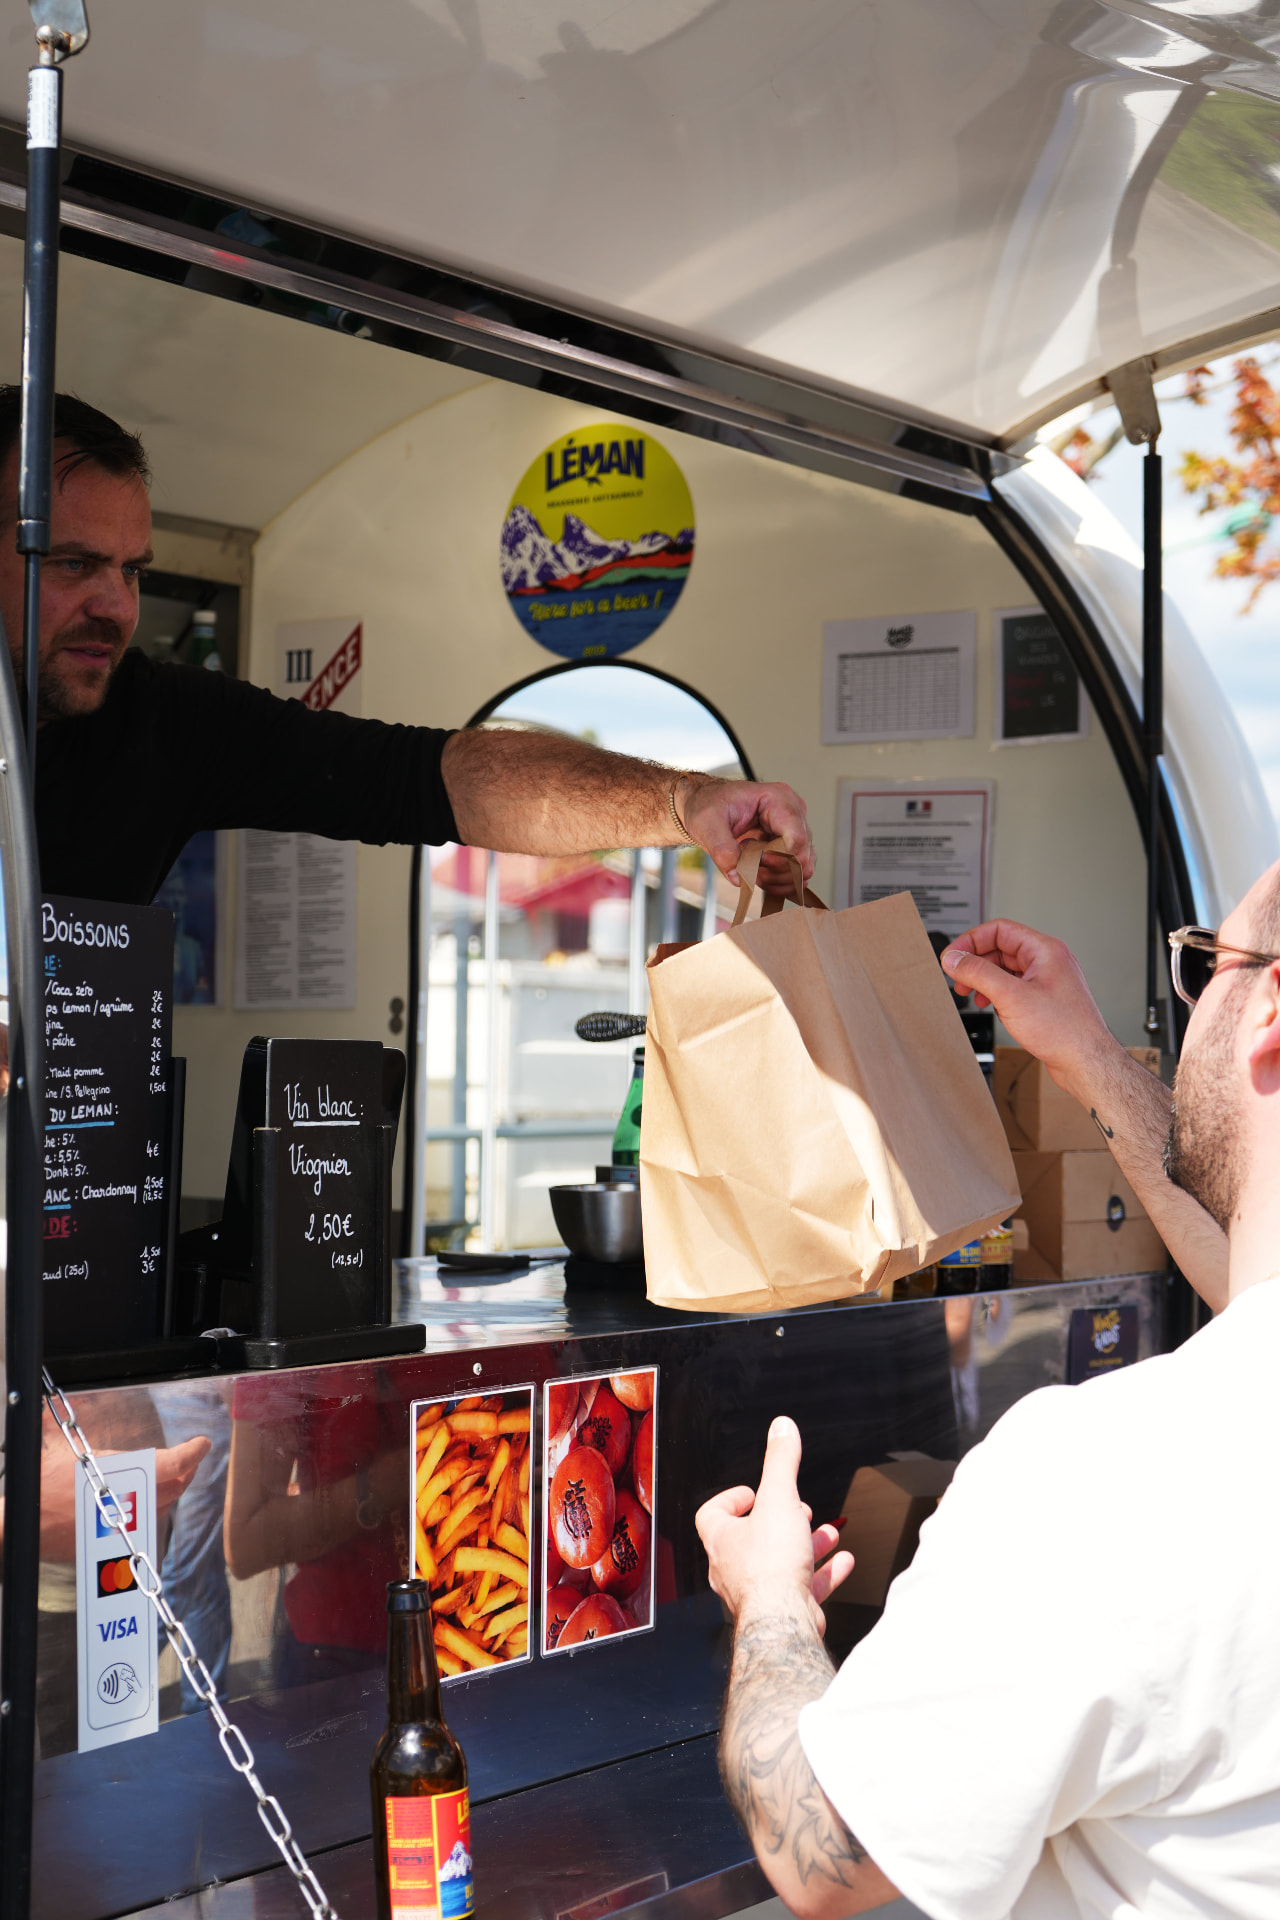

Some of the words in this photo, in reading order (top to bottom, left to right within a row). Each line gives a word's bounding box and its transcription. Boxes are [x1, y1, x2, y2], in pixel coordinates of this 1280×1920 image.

[545, 438, 646, 493] LÉMAN
[598, 599, 611, 613] a
[613, 593, 649, 611] beer
[306, 636, 358, 711] ENCE
[76, 981, 94, 997] zéro
[152, 991, 163, 1002] 2€
[151, 1003, 163, 1013] 2€
[152, 1018, 162, 1029] 2€
[52, 1033, 76, 1050] pêche
[151, 1037, 162, 1048] 2€
[151, 1051, 161, 1062] 2€
[74, 1067, 104, 1080] pomme
[150, 1065, 160, 1076] 2€
[75, 1084, 111, 1101] Pellegrino
[150, 1082, 167, 1094] 1,50€
[284, 1083, 309, 1120] Vin
[49, 1107, 66, 1122] DU
[44, 1134, 60, 1148] he:
[146, 1140, 159, 1158] 4€
[289, 1143, 351, 1196] Viognier
[82, 1183, 137, 1204] Chardonnay
[142, 1190, 163, 1204] (12,5c
[305, 1213, 354, 1244] 2,50€
[142, 1260, 155, 1274] 3€
[97, 1615, 138, 1643] VISA
